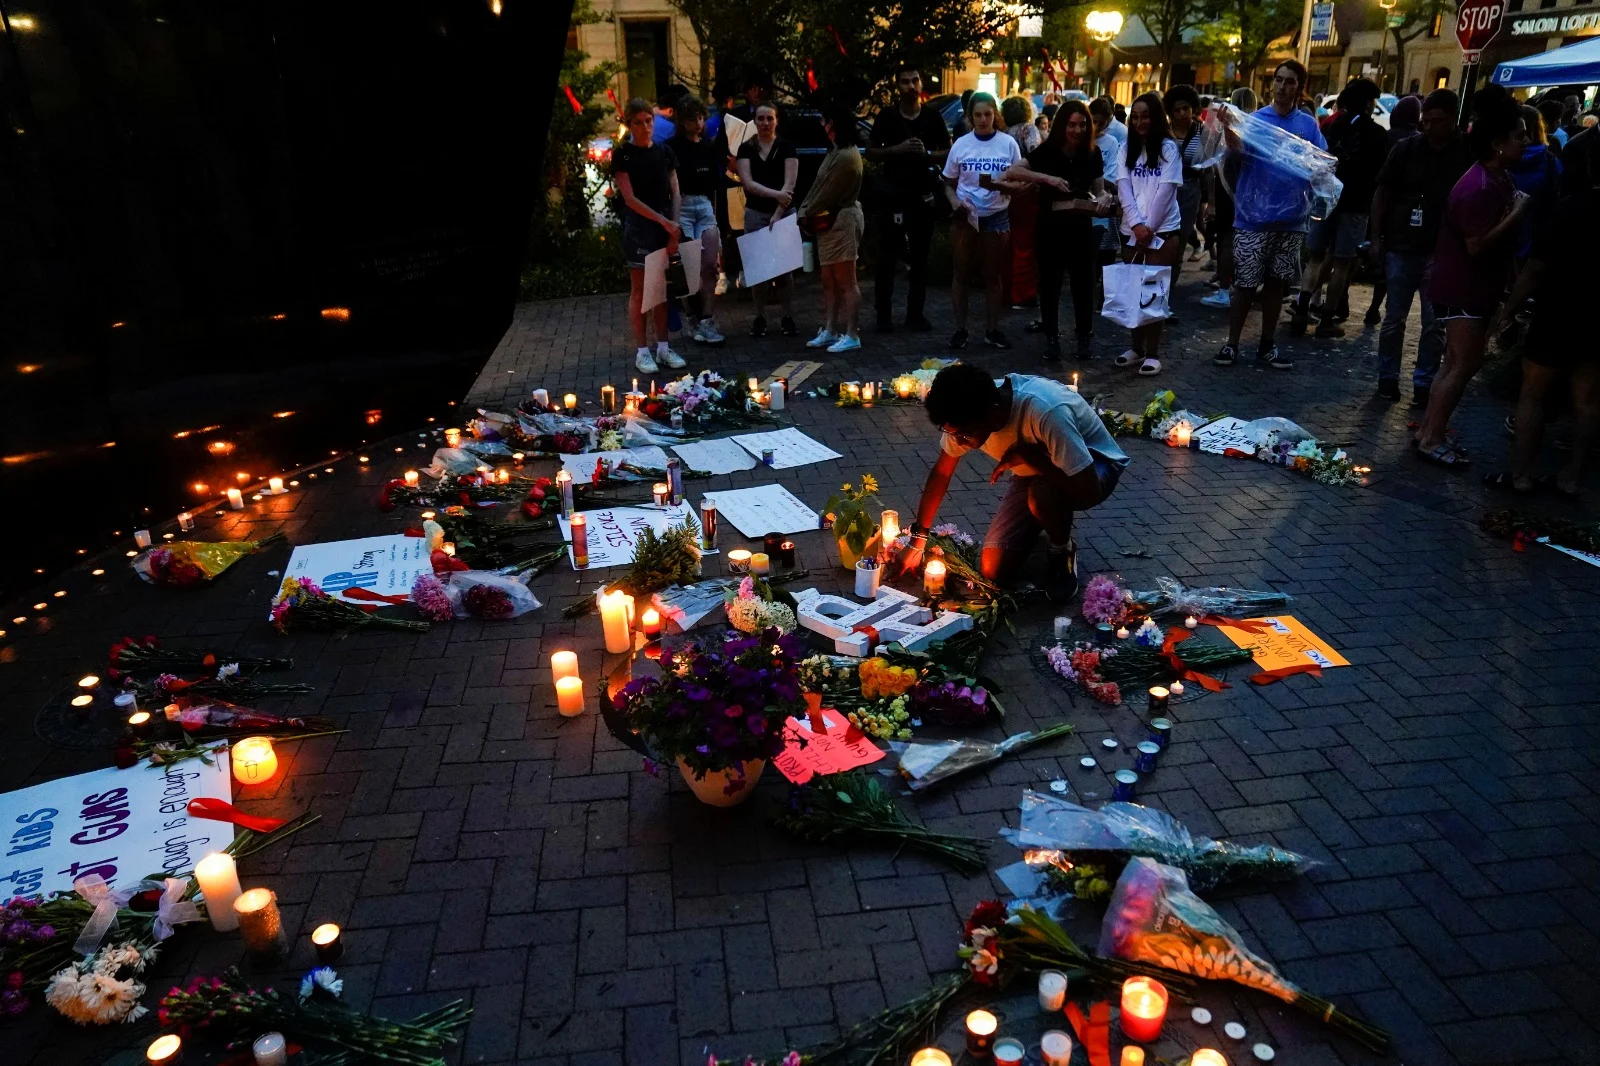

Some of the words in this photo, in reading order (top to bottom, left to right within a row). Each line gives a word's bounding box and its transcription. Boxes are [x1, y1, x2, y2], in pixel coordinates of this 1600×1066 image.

[1459, 5, 1500, 31] STOP
[1511, 17, 1559, 36] SALON
[962, 162, 1007, 172] STRONG
[596, 511, 633, 547] SILENCE
[1251, 629, 1298, 662] CONTRO
[158, 768, 200, 814] enough
[153, 817, 187, 834] is
